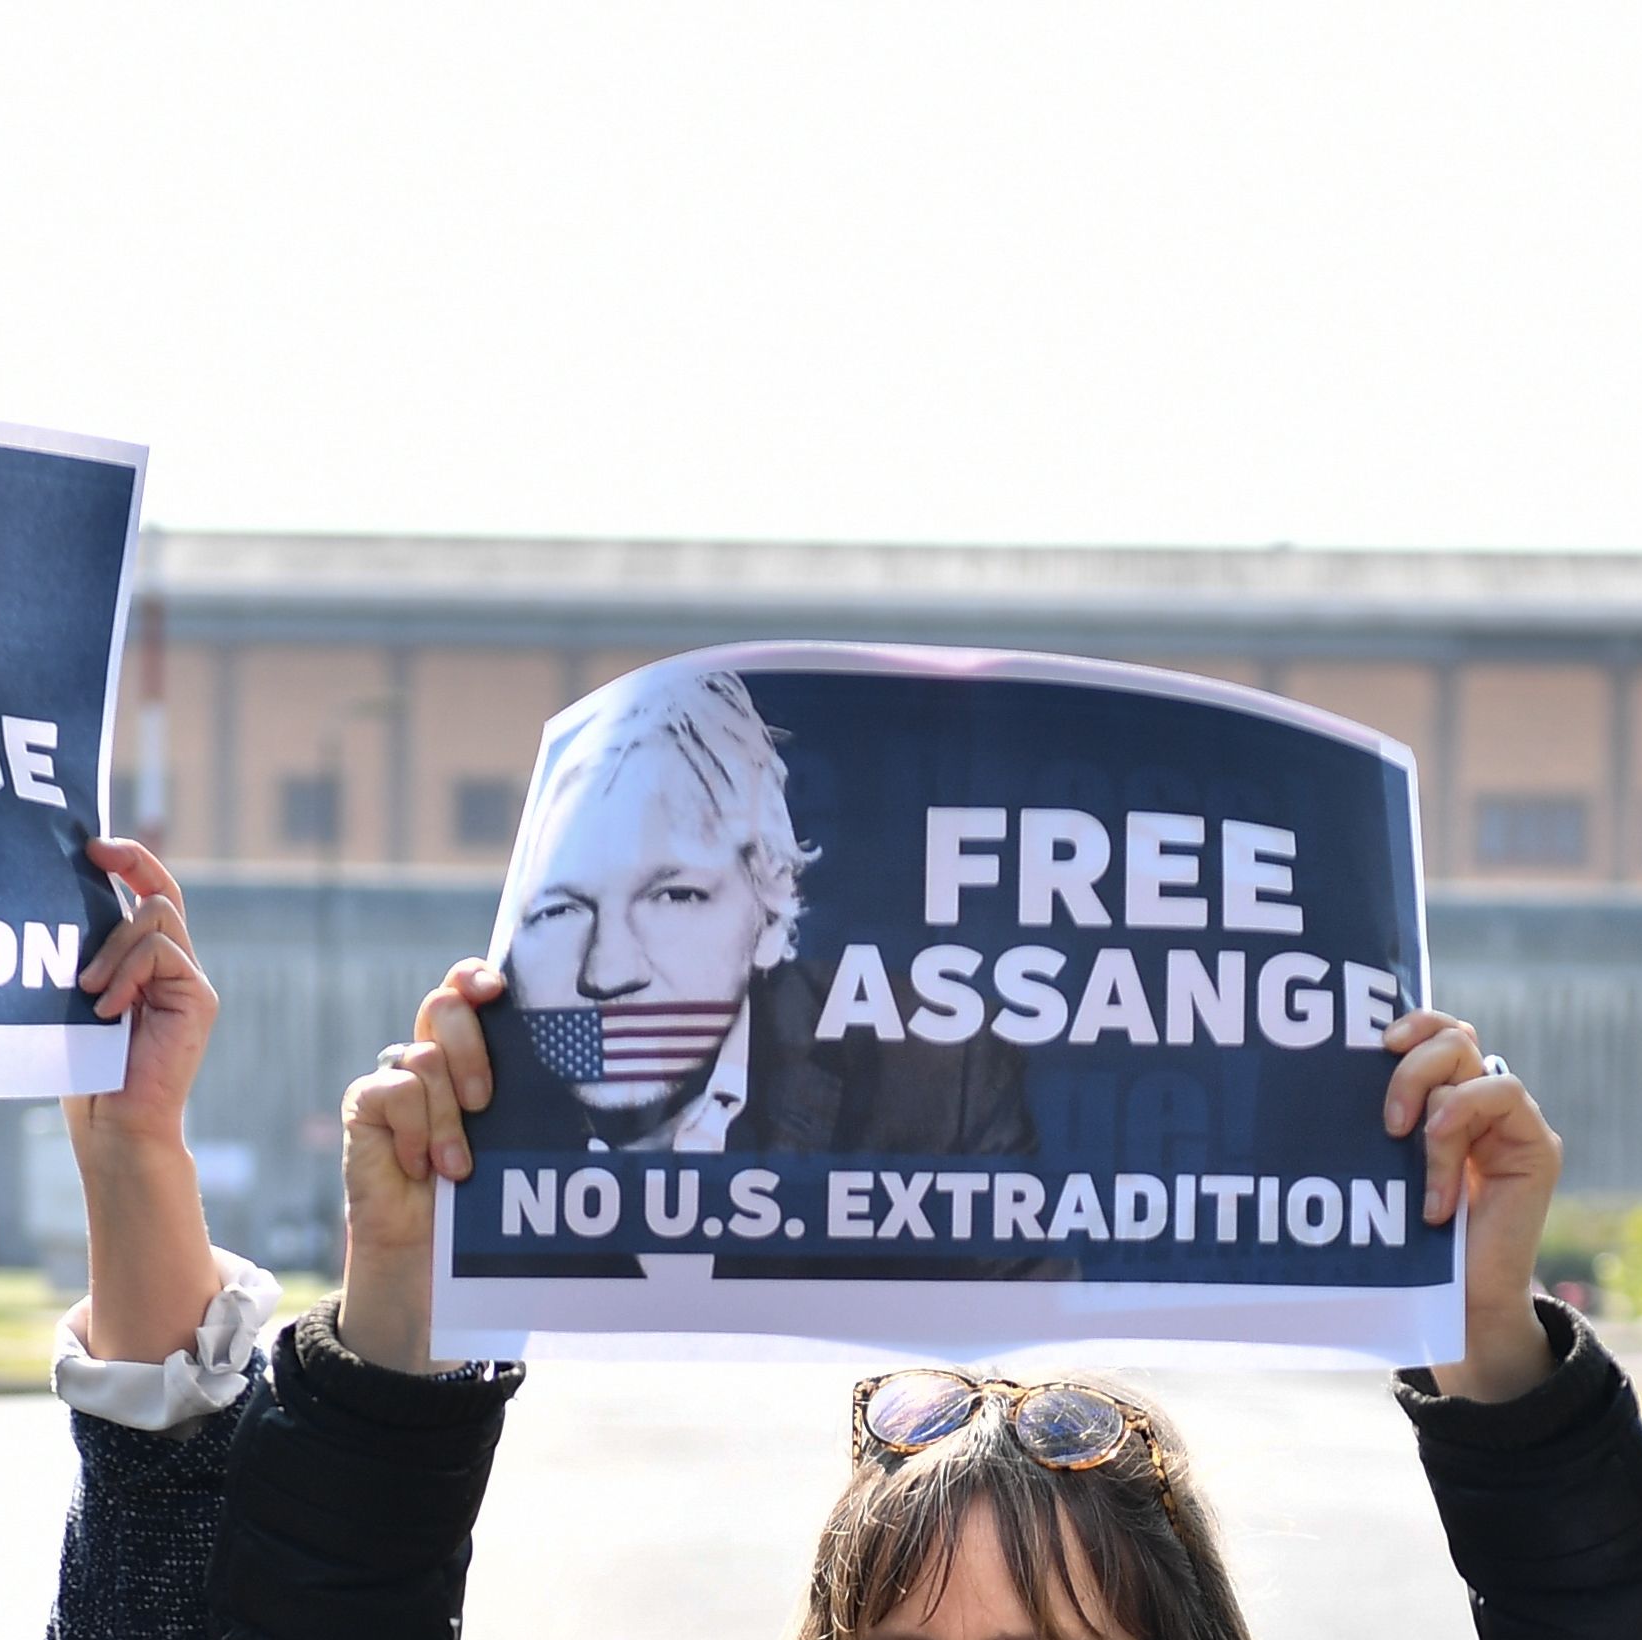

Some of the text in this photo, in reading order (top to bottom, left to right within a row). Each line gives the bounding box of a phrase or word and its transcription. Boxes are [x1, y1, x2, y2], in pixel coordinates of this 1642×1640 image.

[923, 805, 1305, 935] FREE
[813, 943, 1399, 1050] ASSANGE
[501, 1168, 1407, 1248] NO U.S. EXTRADITION
